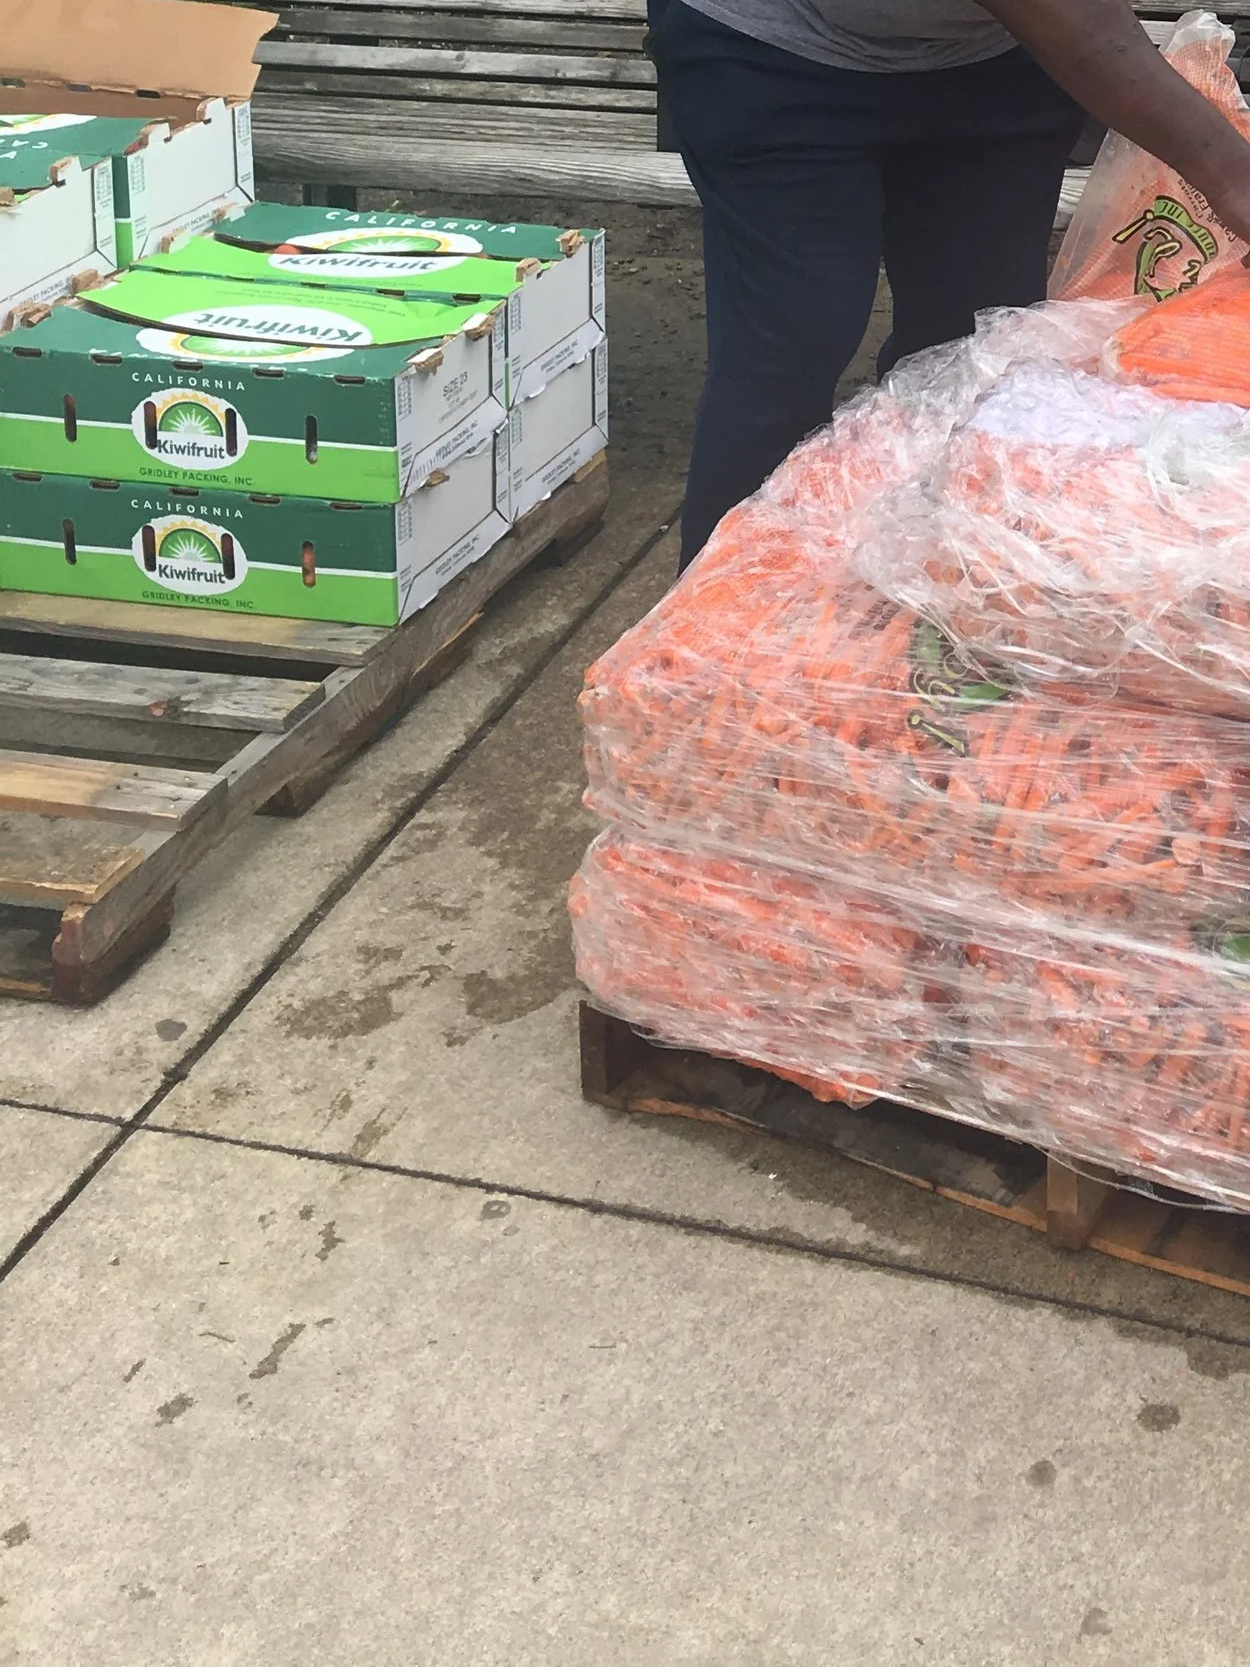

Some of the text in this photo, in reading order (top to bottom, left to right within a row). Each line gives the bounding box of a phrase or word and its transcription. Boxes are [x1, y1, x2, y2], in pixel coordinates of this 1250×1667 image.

[325, 211, 516, 234] CALIFORNIA
[193, 313, 363, 342] Kiwifruit
[131, 372, 245, 391] CALIFORNIA
[157, 439, 225, 459] Kiwifruit
[139, 467, 179, 479] GRIDLEY
[130, 499, 243, 518] CALIFORNIA
[158, 564, 226, 584] Kiwifruit
[141, 590, 181, 602] GRIDLEY
